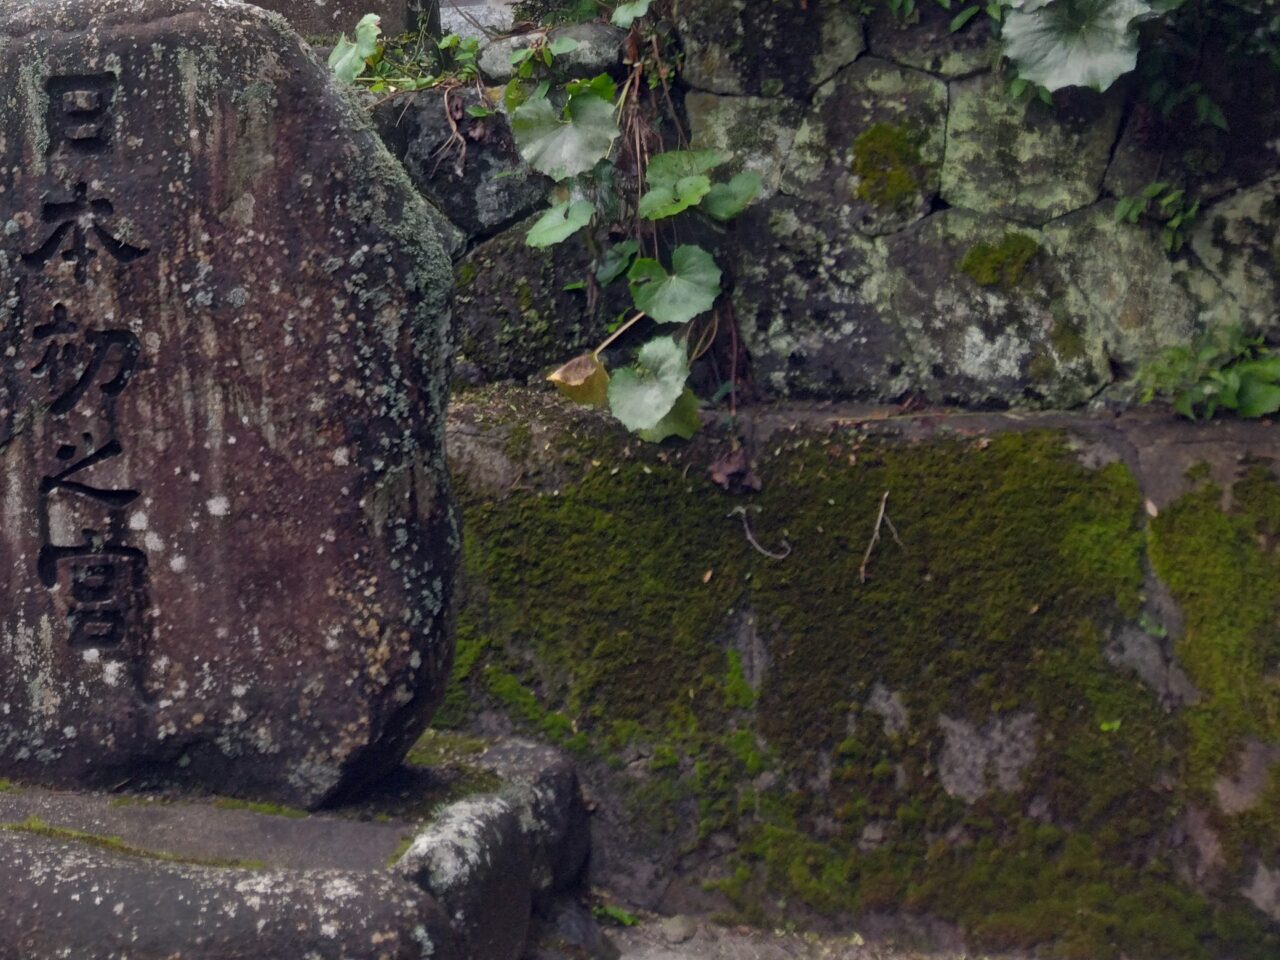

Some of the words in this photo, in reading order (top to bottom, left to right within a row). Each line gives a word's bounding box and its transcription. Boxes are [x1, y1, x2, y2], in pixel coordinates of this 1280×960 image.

[22, 72, 150, 652] 日本初之宮
